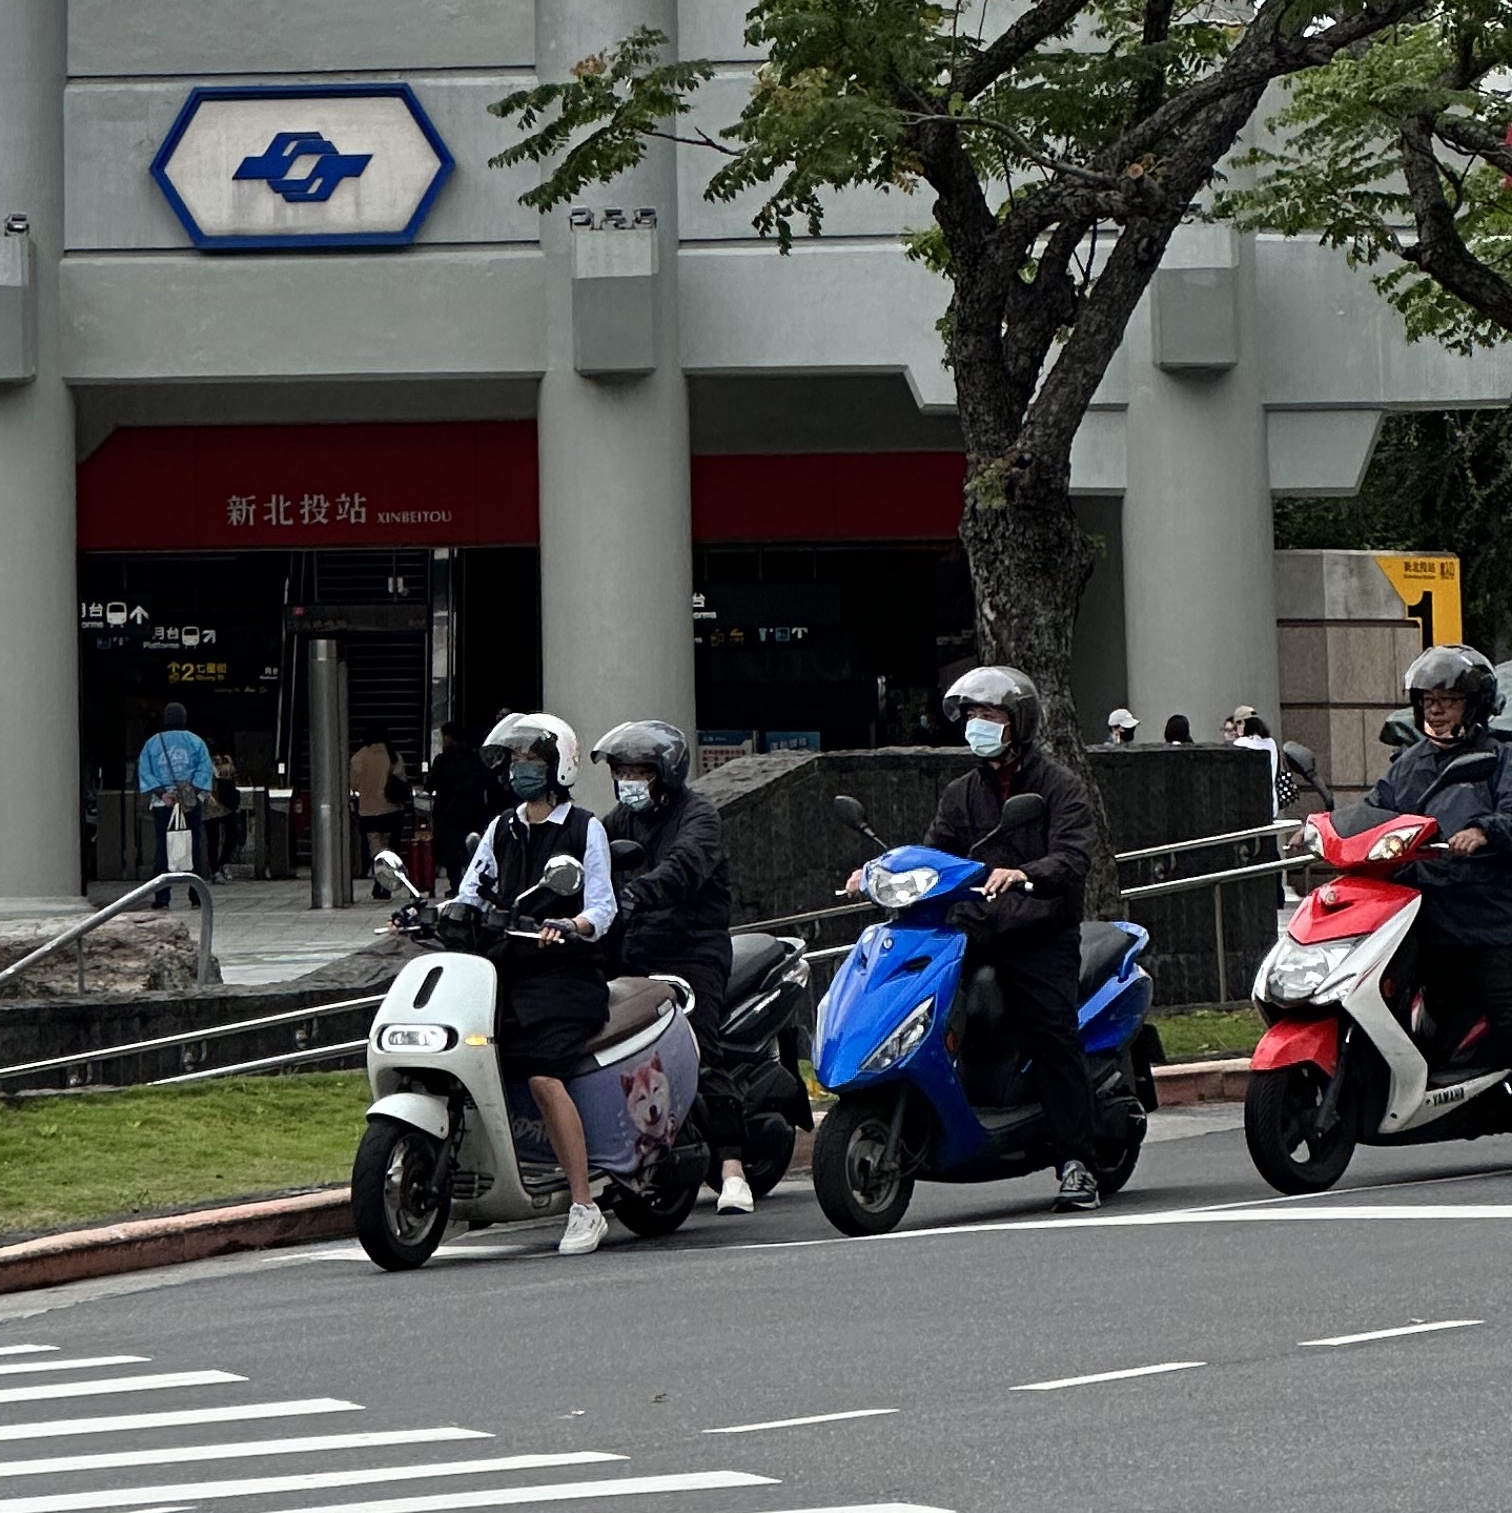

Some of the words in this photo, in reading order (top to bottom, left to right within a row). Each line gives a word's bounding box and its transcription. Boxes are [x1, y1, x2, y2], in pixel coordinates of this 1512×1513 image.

[226, 492, 367, 526] 新北投站
[376, 510, 453, 524] XINBEITOU
[152, 626, 180, 640] 月台
[1407, 590, 1434, 651] 1
[181, 663, 195, 682] 2
